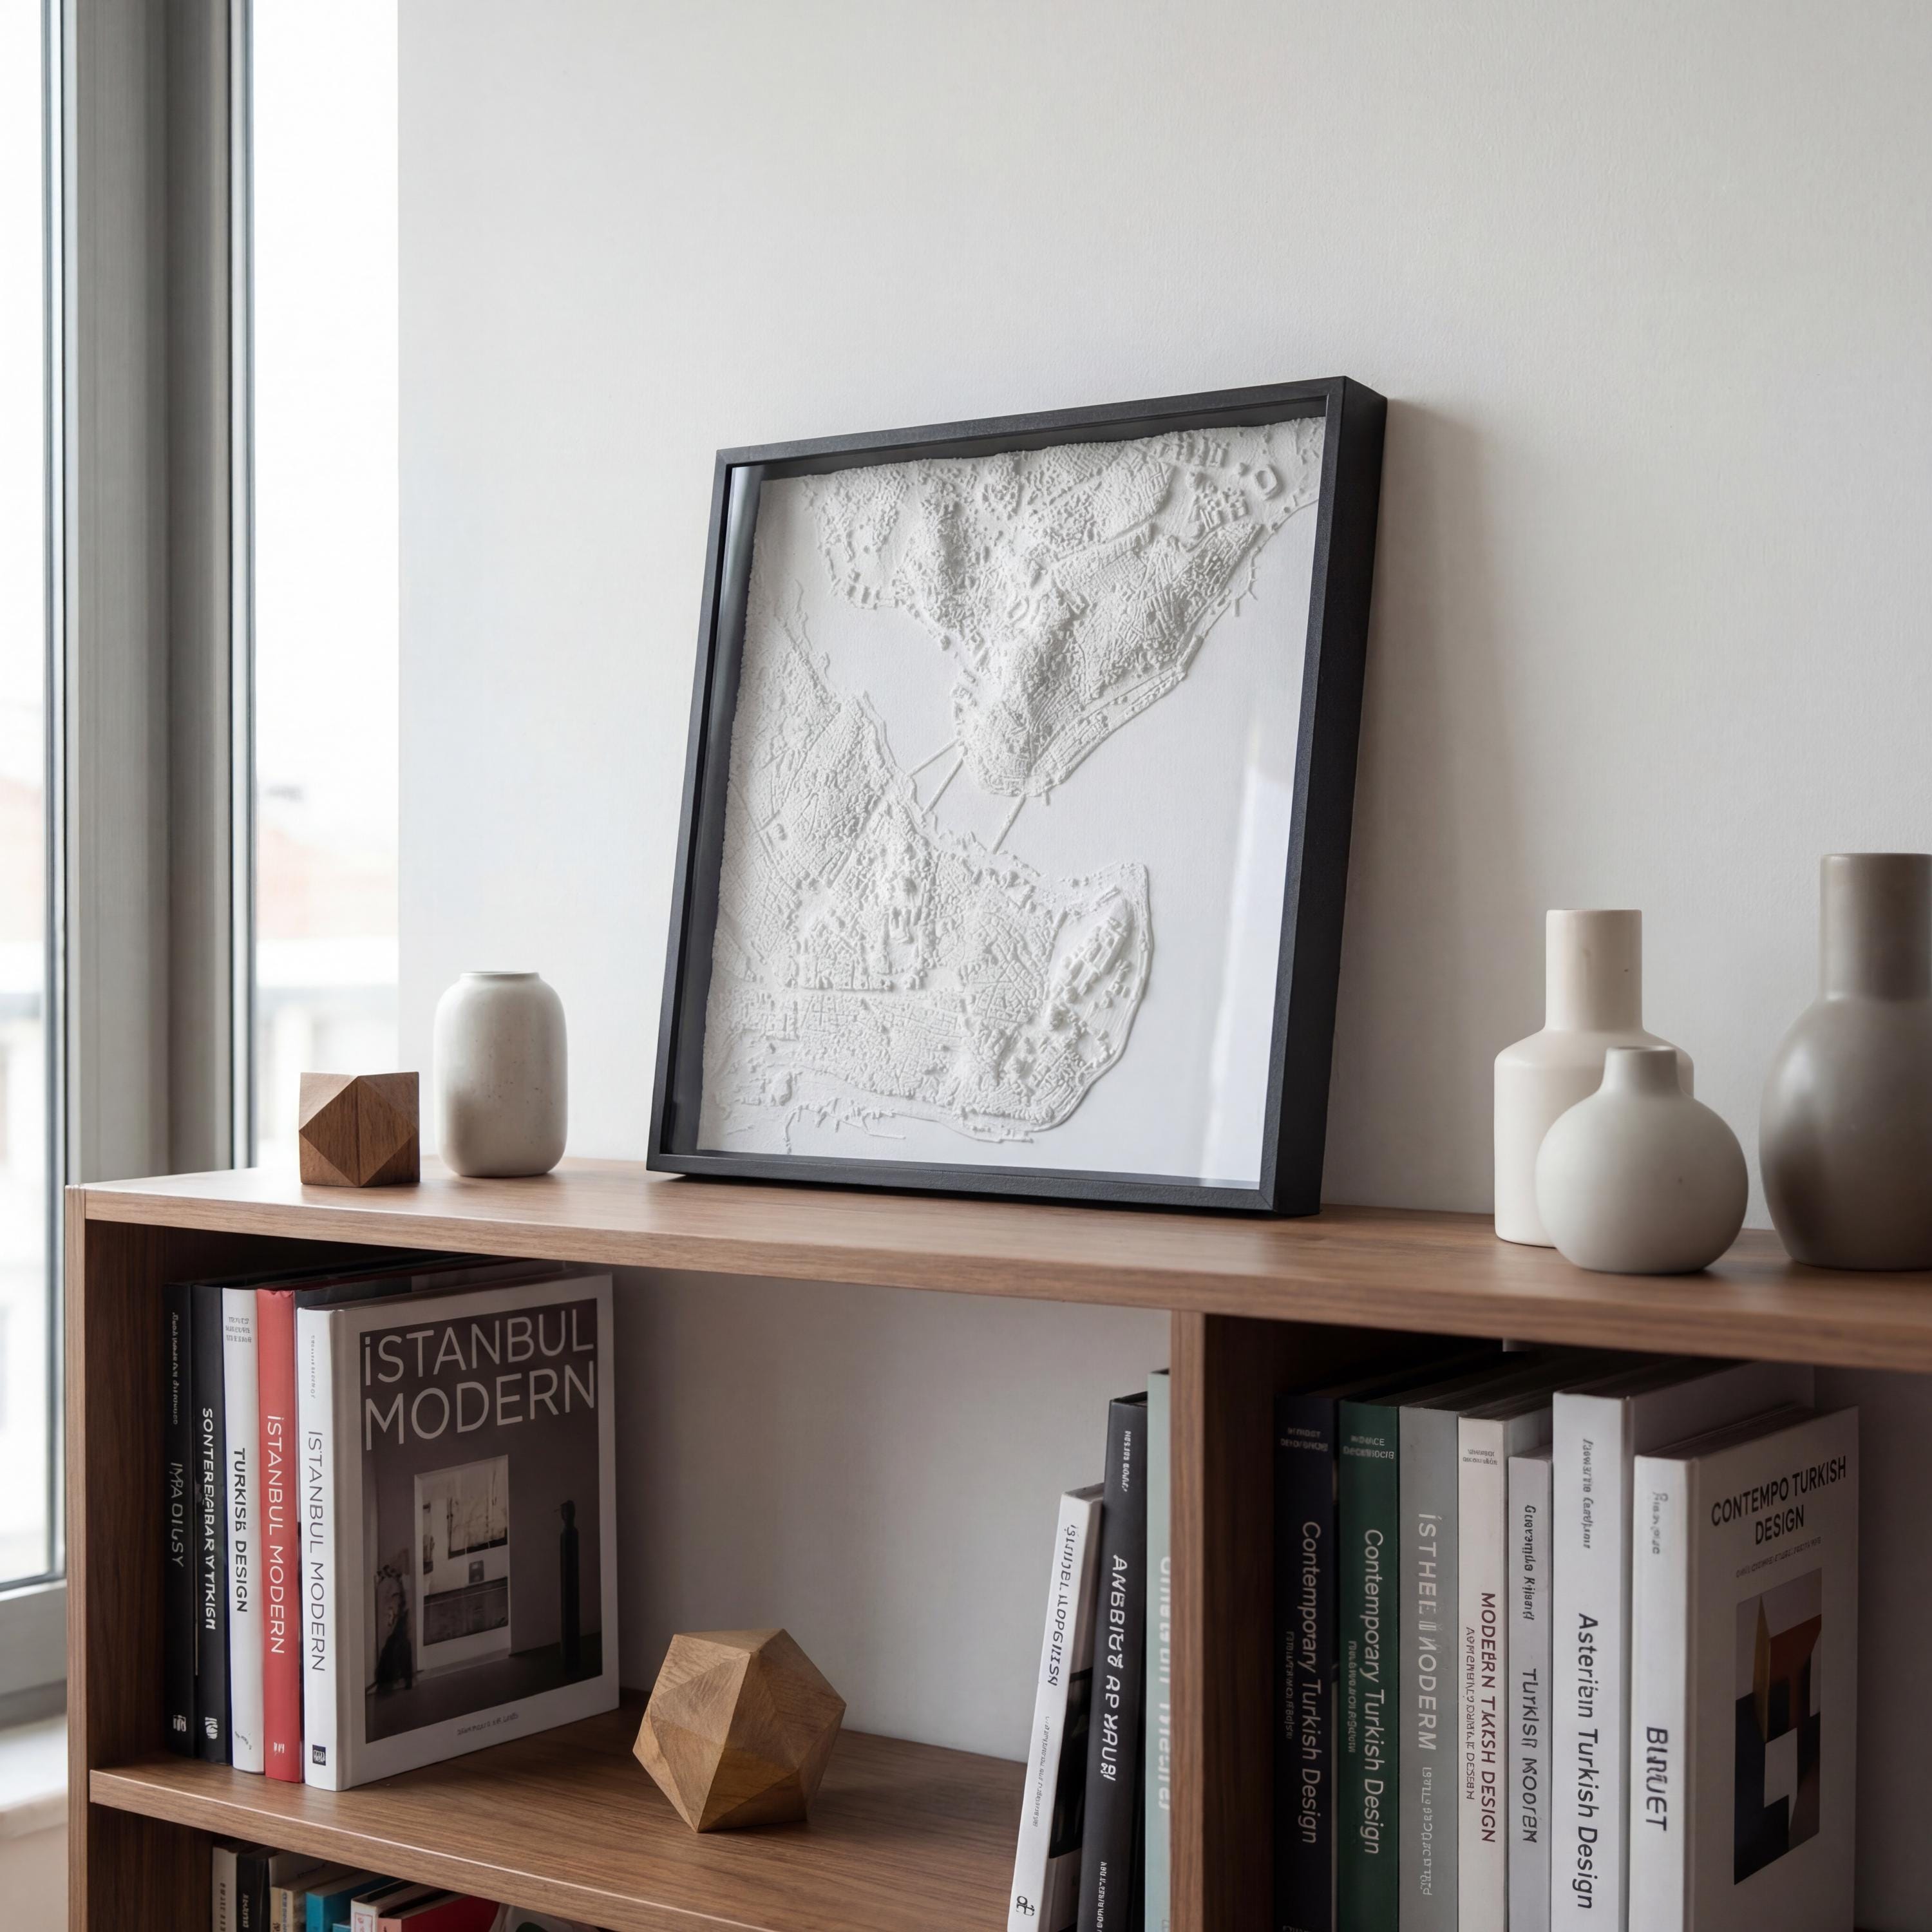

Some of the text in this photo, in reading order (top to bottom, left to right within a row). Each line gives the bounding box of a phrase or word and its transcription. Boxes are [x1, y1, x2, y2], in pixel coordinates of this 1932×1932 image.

[365, 1360, 594, 1451] MODERN
[1711, 1477, 1789, 1526] CONTEMPO
[1792, 1455, 1846, 1496] TURKISH
[1756, 1505, 1804, 1545] DESIGN
[236, 1540, 247, 1612] DESIGN
[270, 1546, 285, 1654] MODERN
[310, 1562, 325, 1671] MODERN
[1302, 1679, 1322, 1759] Turkish
[1365, 1689, 1385, 1770] Turkish
[1298, 1768, 1321, 1843] Design
[1482, 1771, 1495, 1842] DESIGN
[1578, 1728, 1599, 1817] Turkish
[1360, 1779, 1384, 1854] Design
[1572, 1826, 1598, 1909] Design
